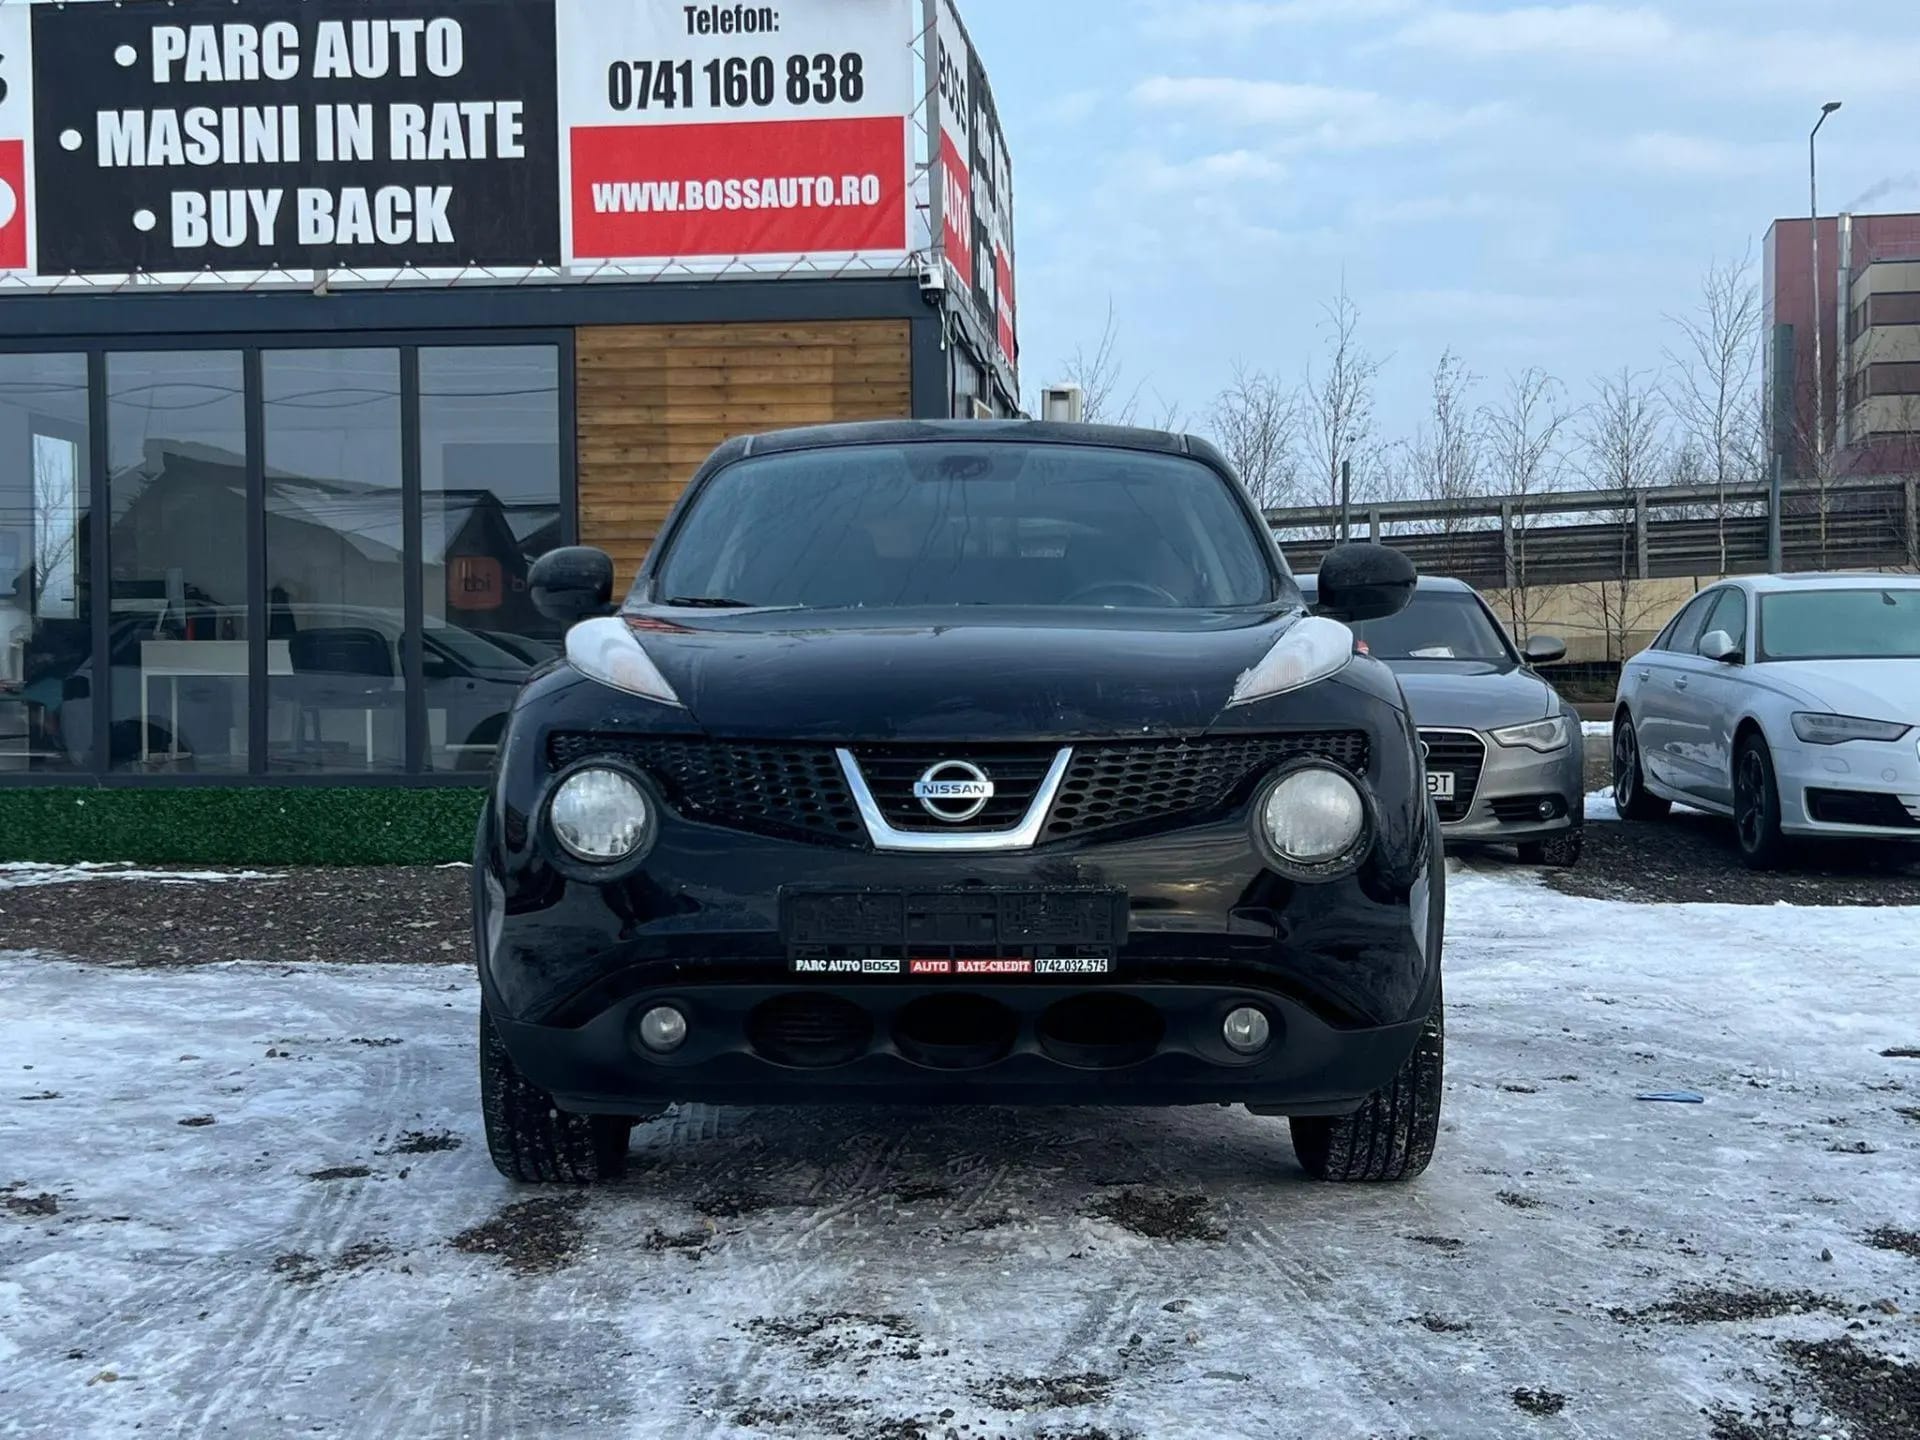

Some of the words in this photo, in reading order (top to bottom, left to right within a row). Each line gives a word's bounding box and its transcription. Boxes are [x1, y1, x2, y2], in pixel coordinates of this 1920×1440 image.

[684, 2, 780, 35] Telefon:
[152, 21, 300, 83] PARC
[312, 17, 464, 79] AUTO
[608, 60, 693, 111] 0741
[703, 55, 774, 107] 160
[785, 52, 864, 105] 838
[938, 34, 967, 137] BOSS
[96, 105, 300, 167] MASINI
[315, 103, 374, 162] IN
[389, 101, 525, 161] RATE
[171, 189, 284, 248] BUY
[297, 186, 455, 245] BACK
[592, 175, 880, 213] WWW.BOSSAUTO.RO
[942, 160, 971, 252] AUTO
[922, 784, 986, 795] NISSAN
[796, 959, 827, 972] PARC
[827, 959, 861, 972] AUTO
[863, 960, 899, 972] BOSS
[913, 960, 949, 972] AUTO
[1036, 960, 1107, 972] 0742.032.575
